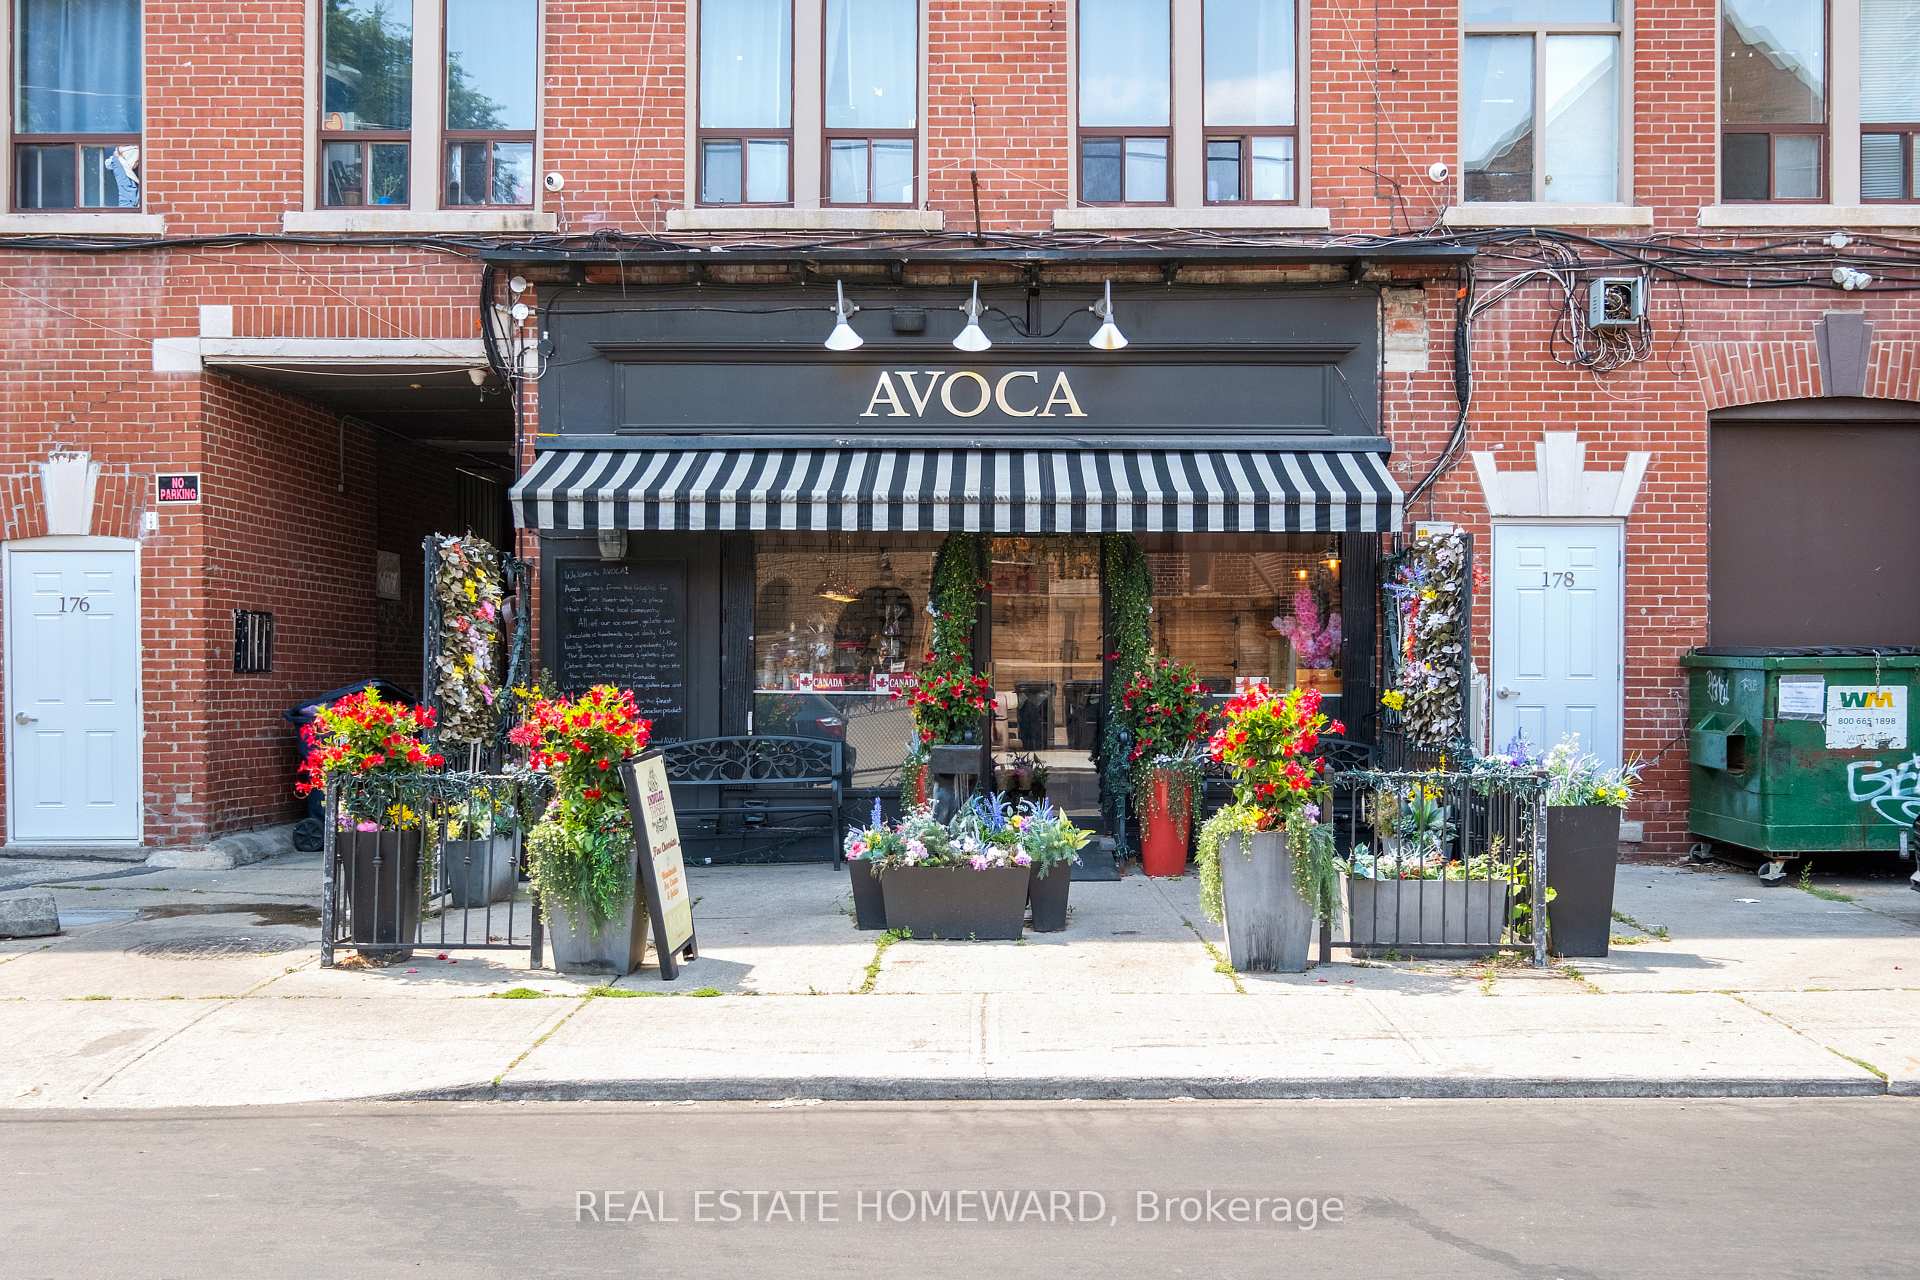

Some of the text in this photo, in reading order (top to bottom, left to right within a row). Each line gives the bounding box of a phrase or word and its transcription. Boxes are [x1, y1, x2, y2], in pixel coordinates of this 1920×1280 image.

[860, 371, 1088, 417] AVOCA
[172, 478, 184, 488] NO
[160, 489, 196, 500] PARKING
[1542, 571, 1574, 588] 178
[59, 596, 90, 613] 176
[813, 678, 843, 688] CANADA
[890, 678, 919, 688] CANADA
[1840, 692, 1895, 708] WM
[1838, 717, 1896, 725] 800 665 1898
